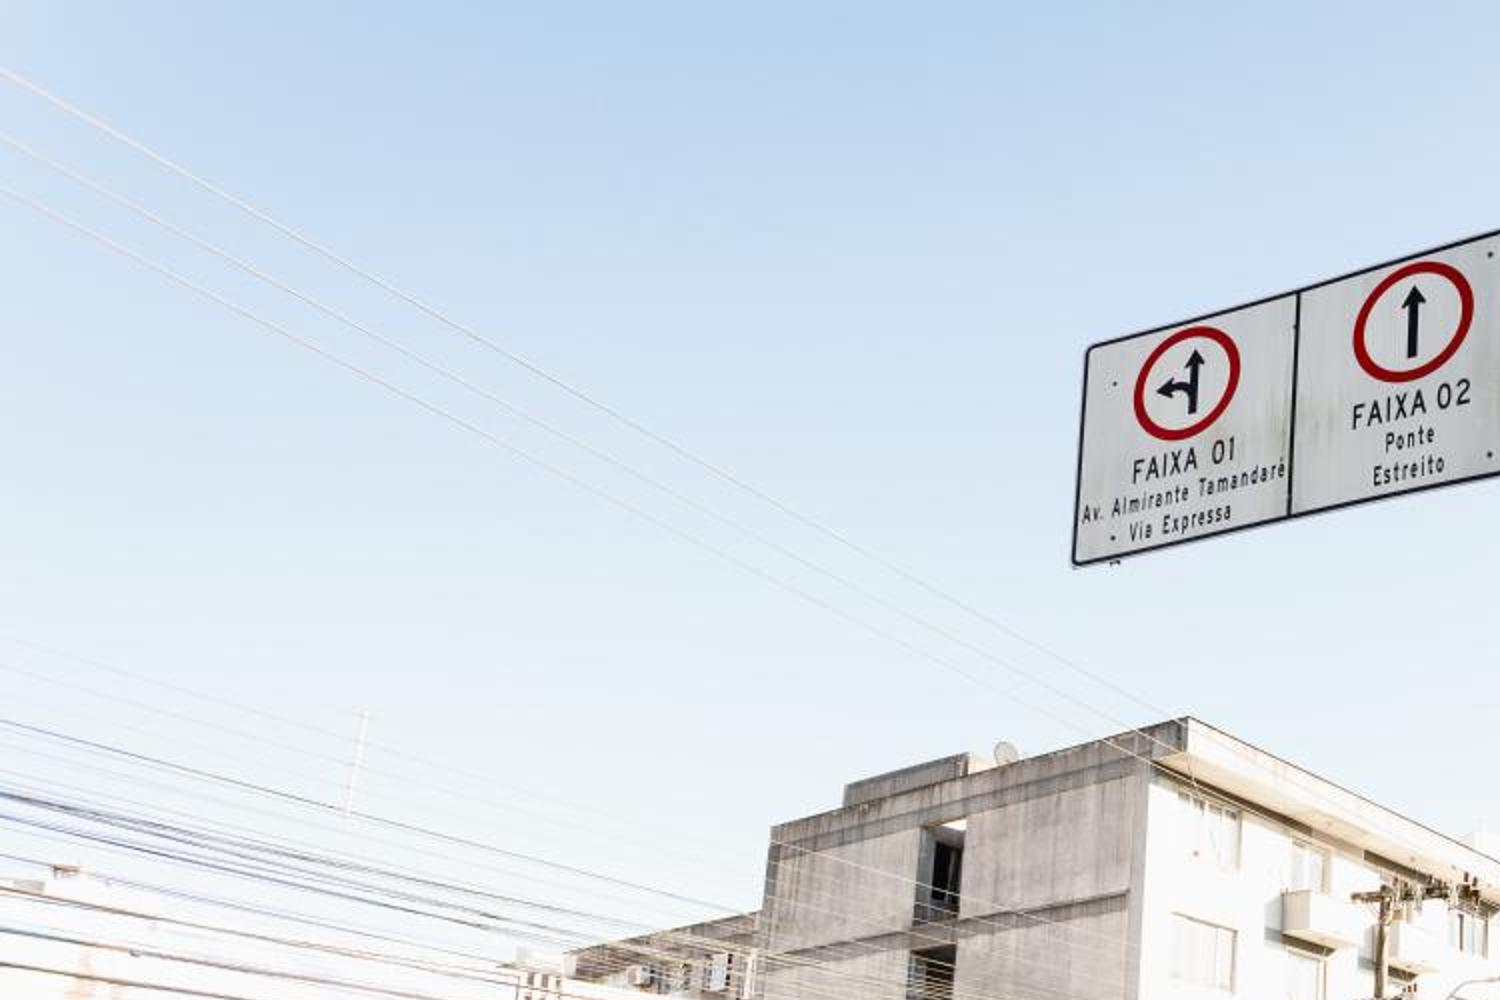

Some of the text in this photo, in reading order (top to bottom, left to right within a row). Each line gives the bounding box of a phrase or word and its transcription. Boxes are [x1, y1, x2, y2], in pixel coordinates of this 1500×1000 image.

[1352, 378, 1472, 431] FAIXA 02
[1133, 436, 1236, 485] FAIXA 01
[1385, 426, 1435, 453] Ponte
[1112, 486, 1189, 518] Almirante
[1199, 456, 1287, 497] Tamandaré
[1373, 456, 1445, 487] Estreito
[1129, 504, 1232, 543] Via Expressa
